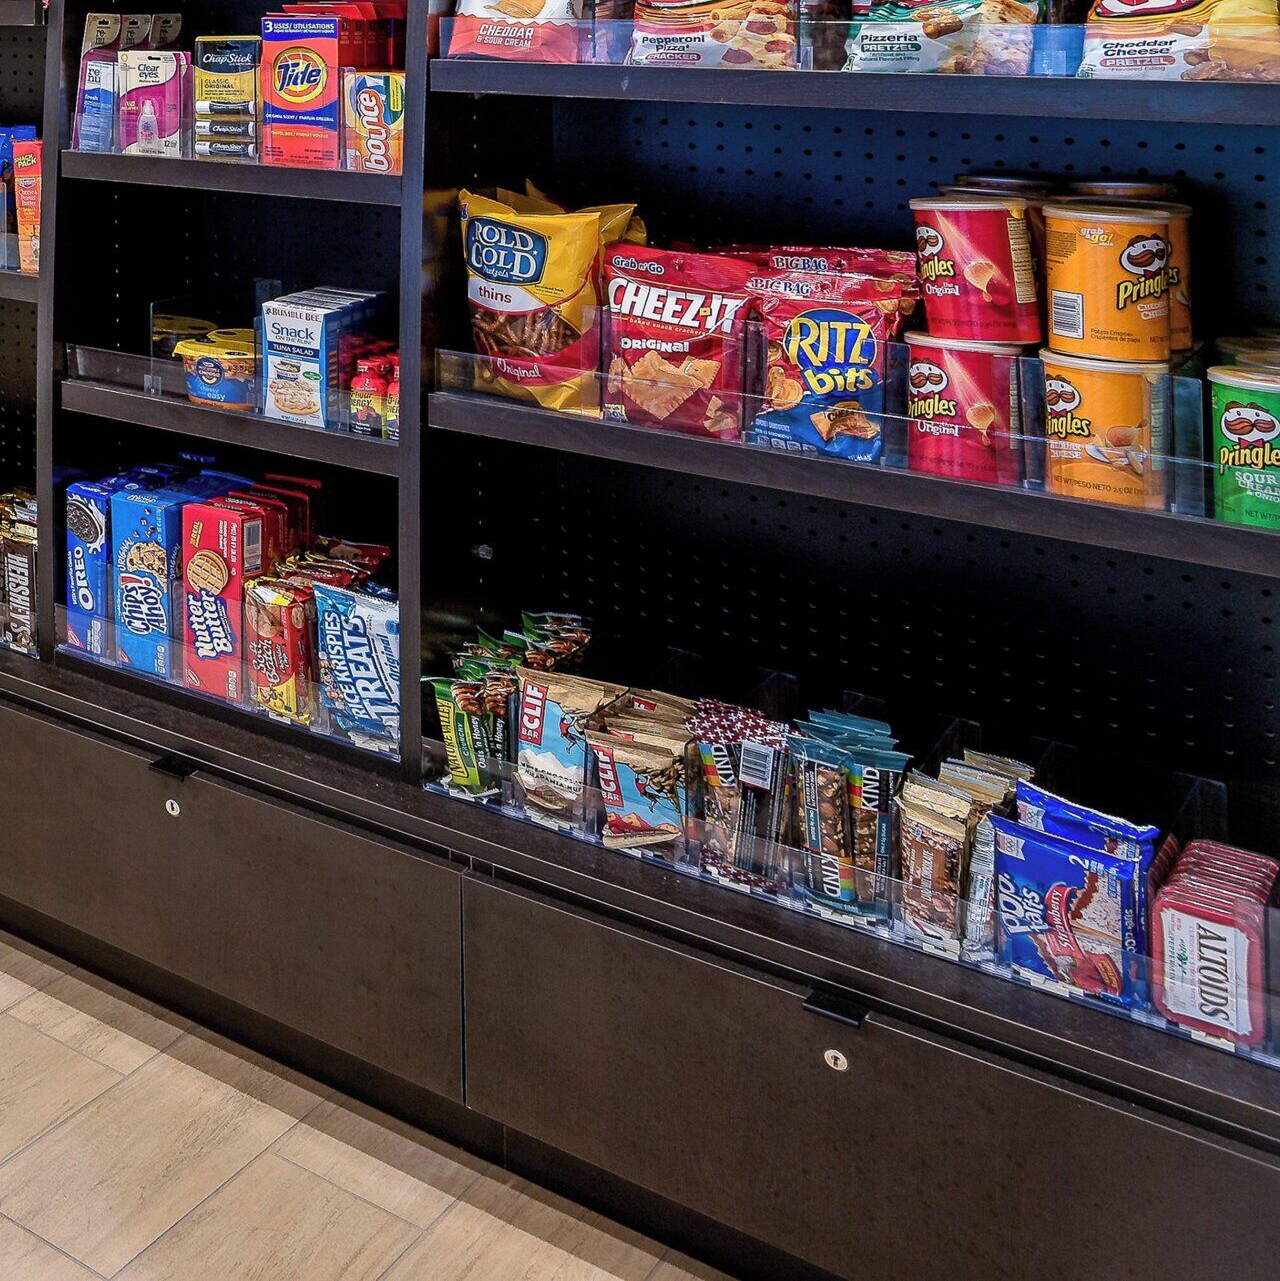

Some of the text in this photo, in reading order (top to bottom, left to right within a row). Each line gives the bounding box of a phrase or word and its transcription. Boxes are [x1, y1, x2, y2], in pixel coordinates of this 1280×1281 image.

[264, 20, 273, 33] 3
[479, 24, 534, 40] CHEDDAR
[483, 36, 531, 48] SOUR CREAM
[642, 34, 705, 45] Pepperoni
[861, 34, 918, 43] Pizzeria
[863, 44, 916, 52] PRETZEL
[1102, 39, 1177, 49] Cheddar
[202, 53, 252, 64] ChapStick
[646, 53, 699, 61] CRACKER
[1104, 47, 1170, 57] Cheese
[1107, 57, 1169, 66] PRETZEL
[138, 64, 160, 72] Clear
[139, 71, 159, 79] eyes
[278, 61, 322, 92] Tide
[359, 92, 390, 171] bounce
[18, 158, 37, 168] PACK
[474, 221, 534, 251] ROLD
[471, 243, 537, 278] GOLD
[612, 255, 664, 274] Grab Go
[773, 256, 828, 271] BIG BAG
[478, 285, 513, 303] thins
[750, 278, 811, 295] BIG BAG
[925, 283, 960, 297] Original
[272, 307, 321, 322] BUMBLE BEE
[608, 277, 749, 334] CHEEZ-IT
[271, 322, 315, 341] Snack
[272, 343, 314, 356] TUNA SALAD
[788, 318, 872, 367] RITZ
[496, 358, 542, 381] Original
[806, 369, 874, 395] bits
[207, 393, 225, 402] easy
[1092, 483, 1111, 492] NETO
[1235, 471, 1278, 485] SOUR
[192, 521, 201, 538] REAL
[74, 546, 95, 611] OREO
[7, 553, 32, 638] HERSHEY'S
[122, 584, 151, 633] Chips
[187, 594, 215, 659] Nutter
[199, 589, 233, 654] Butter
[325, 611, 371, 720] RICE KRISPIES
[342, 615, 400, 721] TREATS
[523, 684, 545, 729] CLIF
[436, 698, 465, 774] NATURE VALLEY
[457, 722, 470, 757] CRUNCHY
[495, 718, 506, 742] Honey
[521, 728, 539, 739] BAR
[470, 715, 487, 769] Oats Honey
[595, 750, 616, 794] CLIF
[712, 743, 736, 787] KIND
[602, 791, 620, 801] BAR
[861, 766, 881, 811] KIND
[820, 853, 841, 898] KIND
[1046, 889, 1075, 952] Strawberry
[1197, 922, 1230, 1022] ALTOIDS
